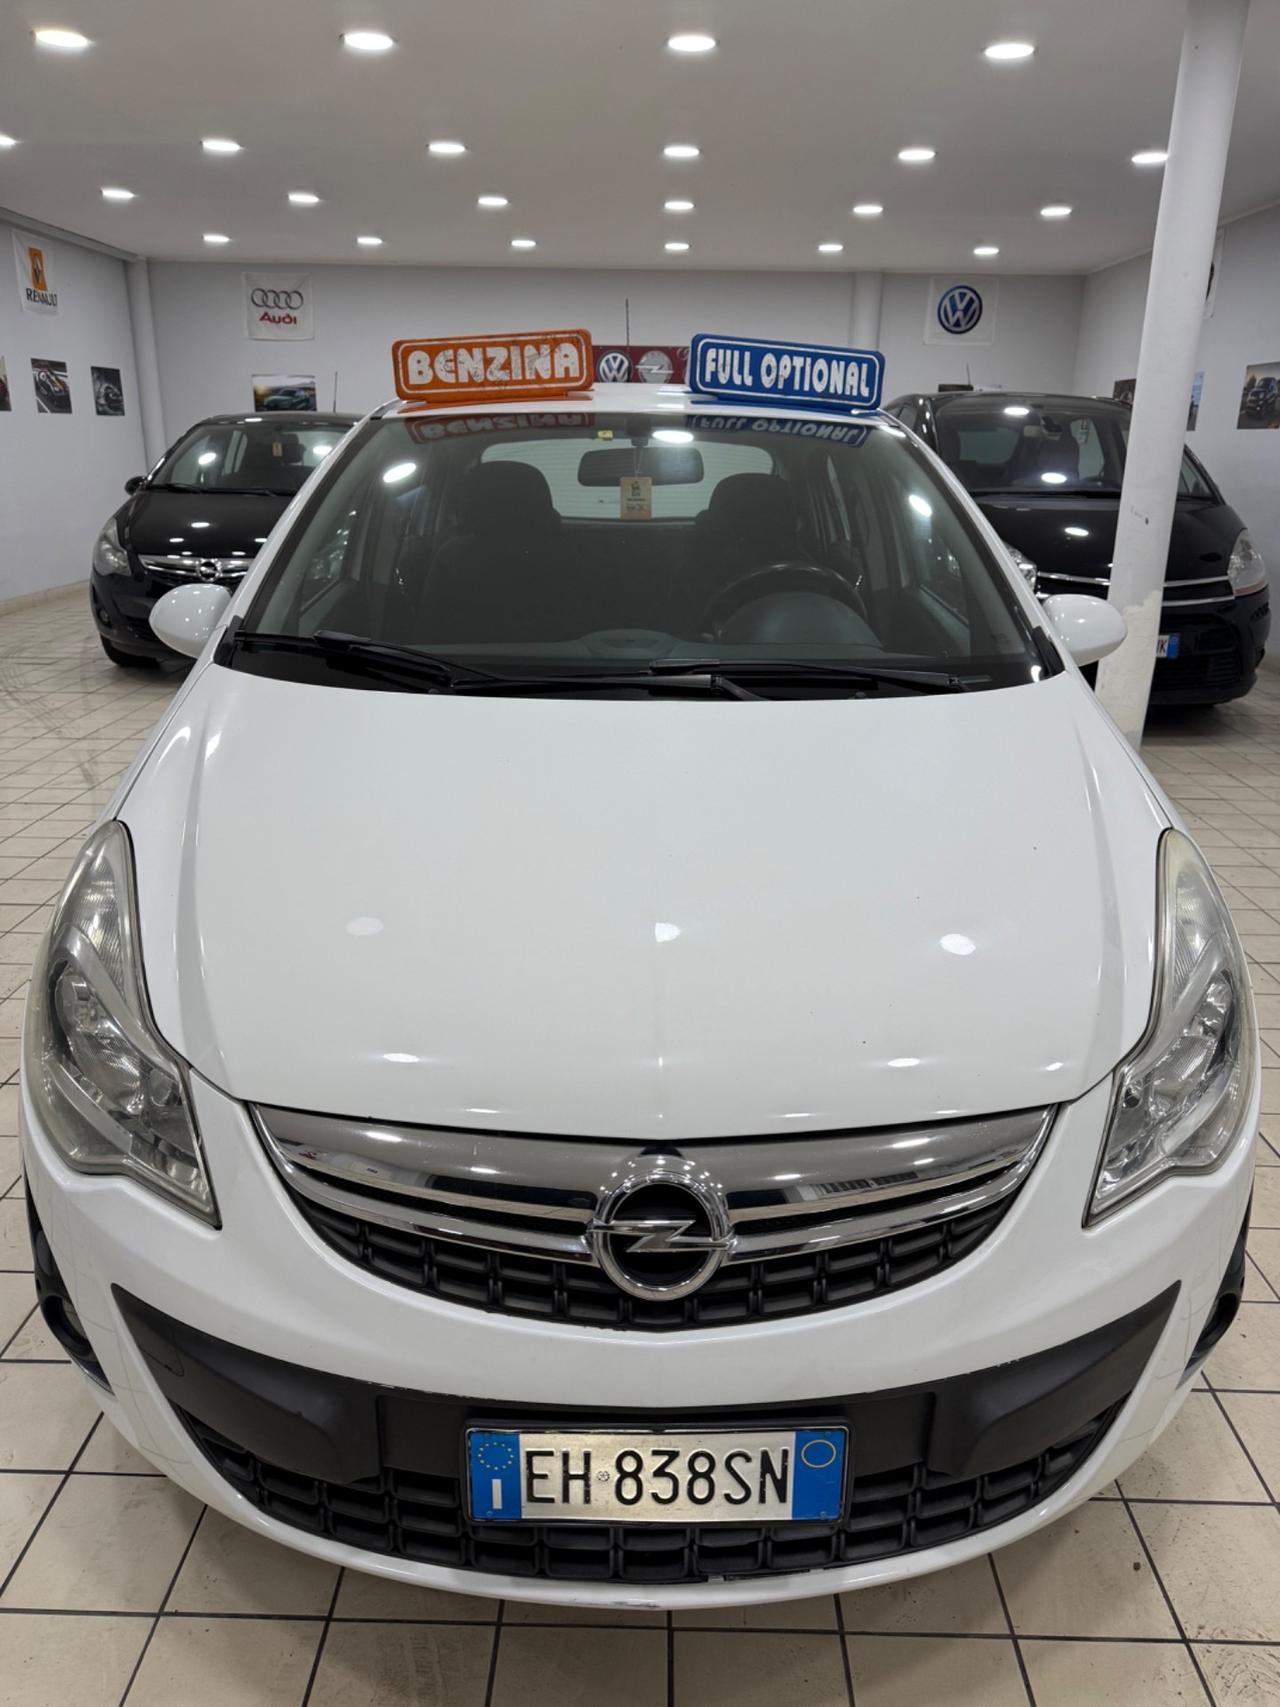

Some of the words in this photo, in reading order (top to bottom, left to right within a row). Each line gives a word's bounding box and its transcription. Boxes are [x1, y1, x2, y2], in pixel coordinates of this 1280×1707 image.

[259, 311, 297, 324] Audi
[407, 343, 580, 385] BENZINA
[705, 348, 753, 386] FULL
[760, 352, 870, 397] OPTIONAL
[524, 1450, 592, 1505] EH
[614, 1447, 790, 1506] 838SN
